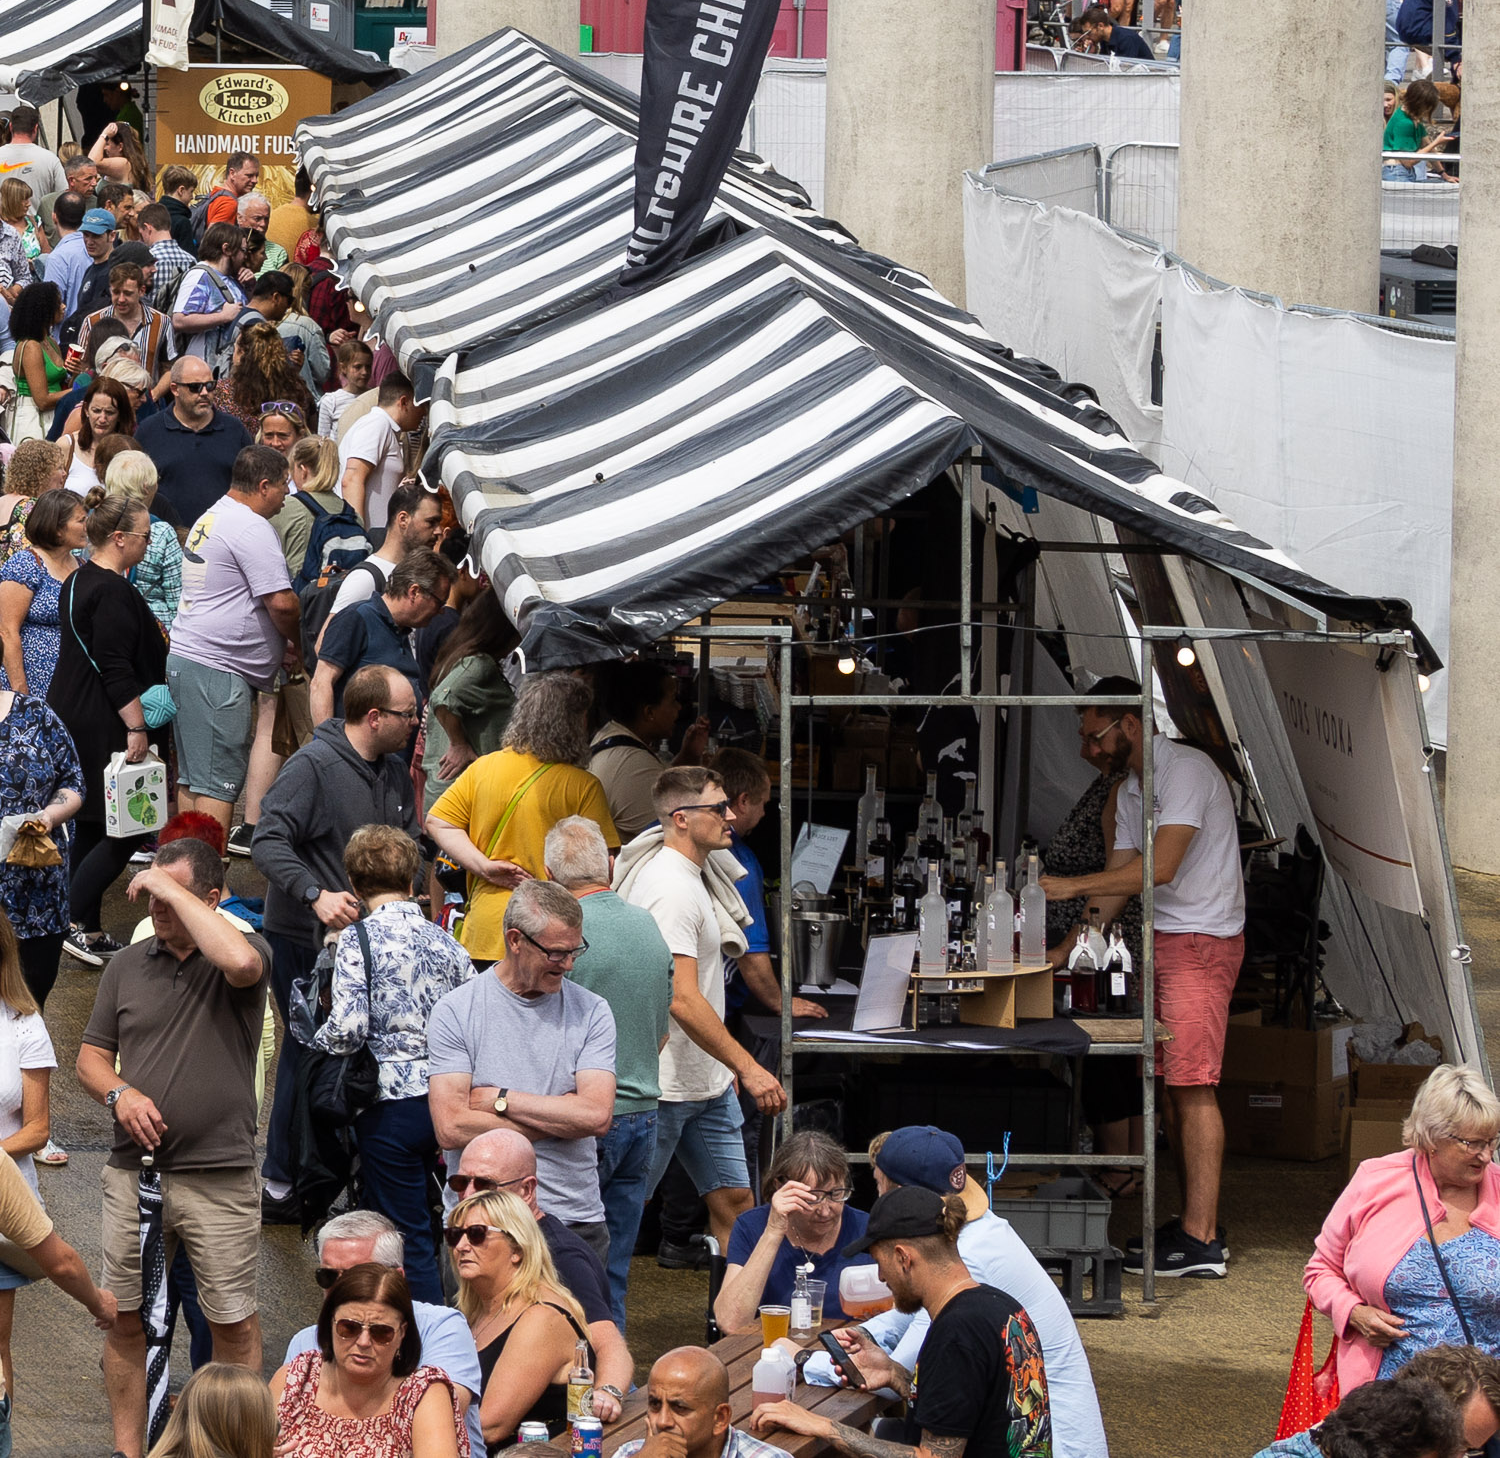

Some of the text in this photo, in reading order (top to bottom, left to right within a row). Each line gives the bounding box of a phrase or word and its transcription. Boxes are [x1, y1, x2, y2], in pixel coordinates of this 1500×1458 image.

[215, 77, 274, 92] Edward's
[222, 92, 268, 109] Fudge
[217, 108, 272, 124] Kitchen
[174, 134, 261, 154] HANDMADE
[1314, 705, 1354, 759] VODKA
